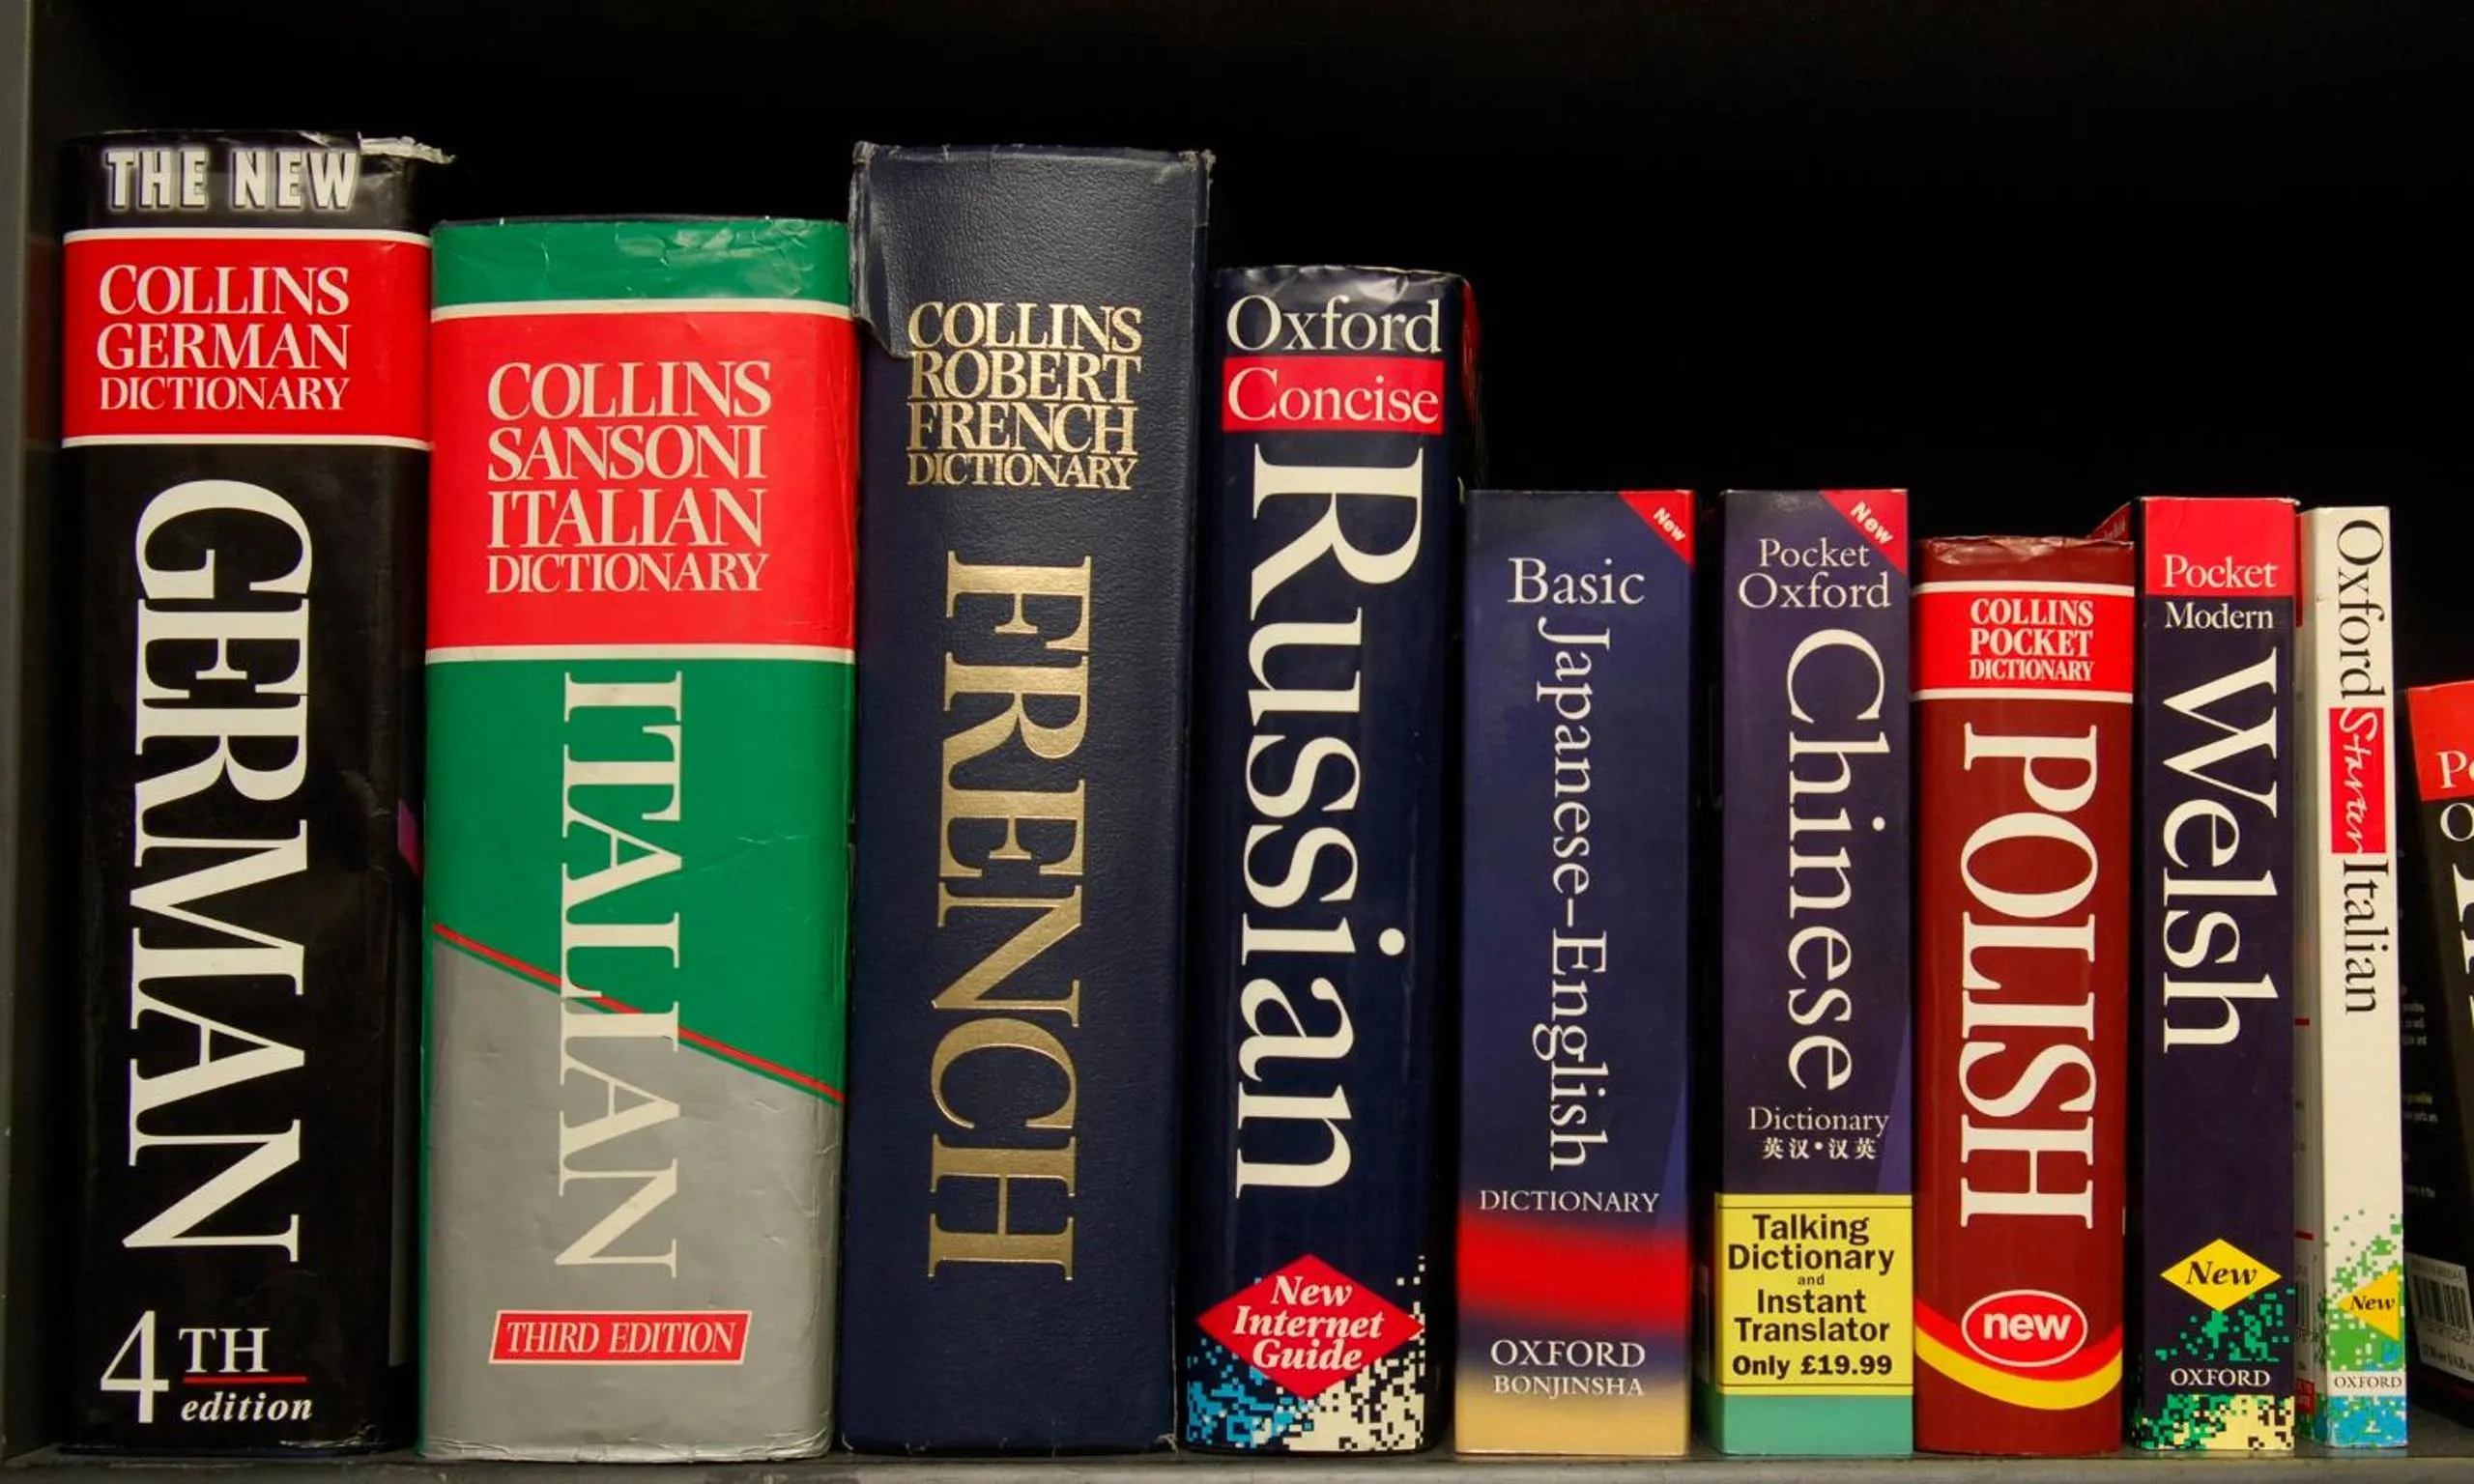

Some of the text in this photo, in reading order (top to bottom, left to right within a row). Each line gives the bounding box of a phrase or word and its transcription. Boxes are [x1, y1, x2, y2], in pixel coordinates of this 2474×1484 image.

[105, 148, 359, 211] THE NEW
[100, 265, 350, 315] COLLINS
[907, 302, 1142, 350] COLLINS
[1226, 294, 1442, 354] Oxford
[97, 324, 351, 371] GERMAN
[100, 377, 351, 412] DICTIONARY
[487, 360, 772, 420] COLLINS
[908, 351, 1142, 404] ROBERT
[1227, 367, 1439, 424] Concise
[906, 401, 1138, 456] FRENCH
[488, 425, 768, 483] SANSONI
[907, 453, 1139, 490] DICTIONARY
[487, 489, 765, 549] ITALIAN
[1653, 507, 1685, 543] New
[1850, 500, 1893, 546] New
[1759, 537, 1869, 568] Pocket
[487, 553, 769, 594] DICTIONARY
[1508, 556, 1645, 605] Basic
[2163, 554, 2278, 588] Pocket
[1739, 571, 1891, 609] Oxford
[1971, 598, 2093, 626] COLLINS
[2165, 602, 2274, 630] Modern
[2336, 519, 2386, 700] Oxford
[1970, 628, 2093, 657] POCKET
[1969, 659, 2094, 682] DICTIONARY
[2338, 707, 2378, 854] Starter
[1235, 442, 1424, 1200] Russian
[1786, 627, 1890, 1092] Chinese
[2162, 645, 2280, 1053] Welsh
[122, 479, 313, 1263] GERMAN
[927, 550, 1092, 1281] FRENCH
[2342, 858, 2389, 1015] Italian
[554, 671, 682, 1279] ITALIAN
[1958, 722, 2099, 1229] POLISH
[1748, 1105, 1889, 1134] Dictionary
[1480, 1189, 1660, 1213] DICTIONARY
[1752, 1213, 1870, 1245] Talking
[1728, 1243, 1894, 1275] Dictionary
[2186, 1261, 2258, 1286] New
[1271, 1276, 1353, 1307] New
[1798, 1274, 1825, 1286] and
[1757, 1290, 1866, 1315] Instant
[2349, 1296, 2396, 1312] New
[506, 1322, 737, 1354] THIRD EDITION
[1232, 1306, 1383, 1339] Internet
[1735, 1317, 1889, 1343] Translator
[1983, 1310, 2071, 1341] new
[1252, 1338, 1363, 1372] Guide
[1490, 1339, 1646, 1369] OXFORD
[1733, 1355, 1892, 1379] Only £19.99
[1493, 1375, 1644, 1400] BONJINSHA
[2171, 1367, 2271, 1387] OXFORD
[2334, 1375, 2402, 1390] OXFORD
[181, 1391, 313, 1422] edition
